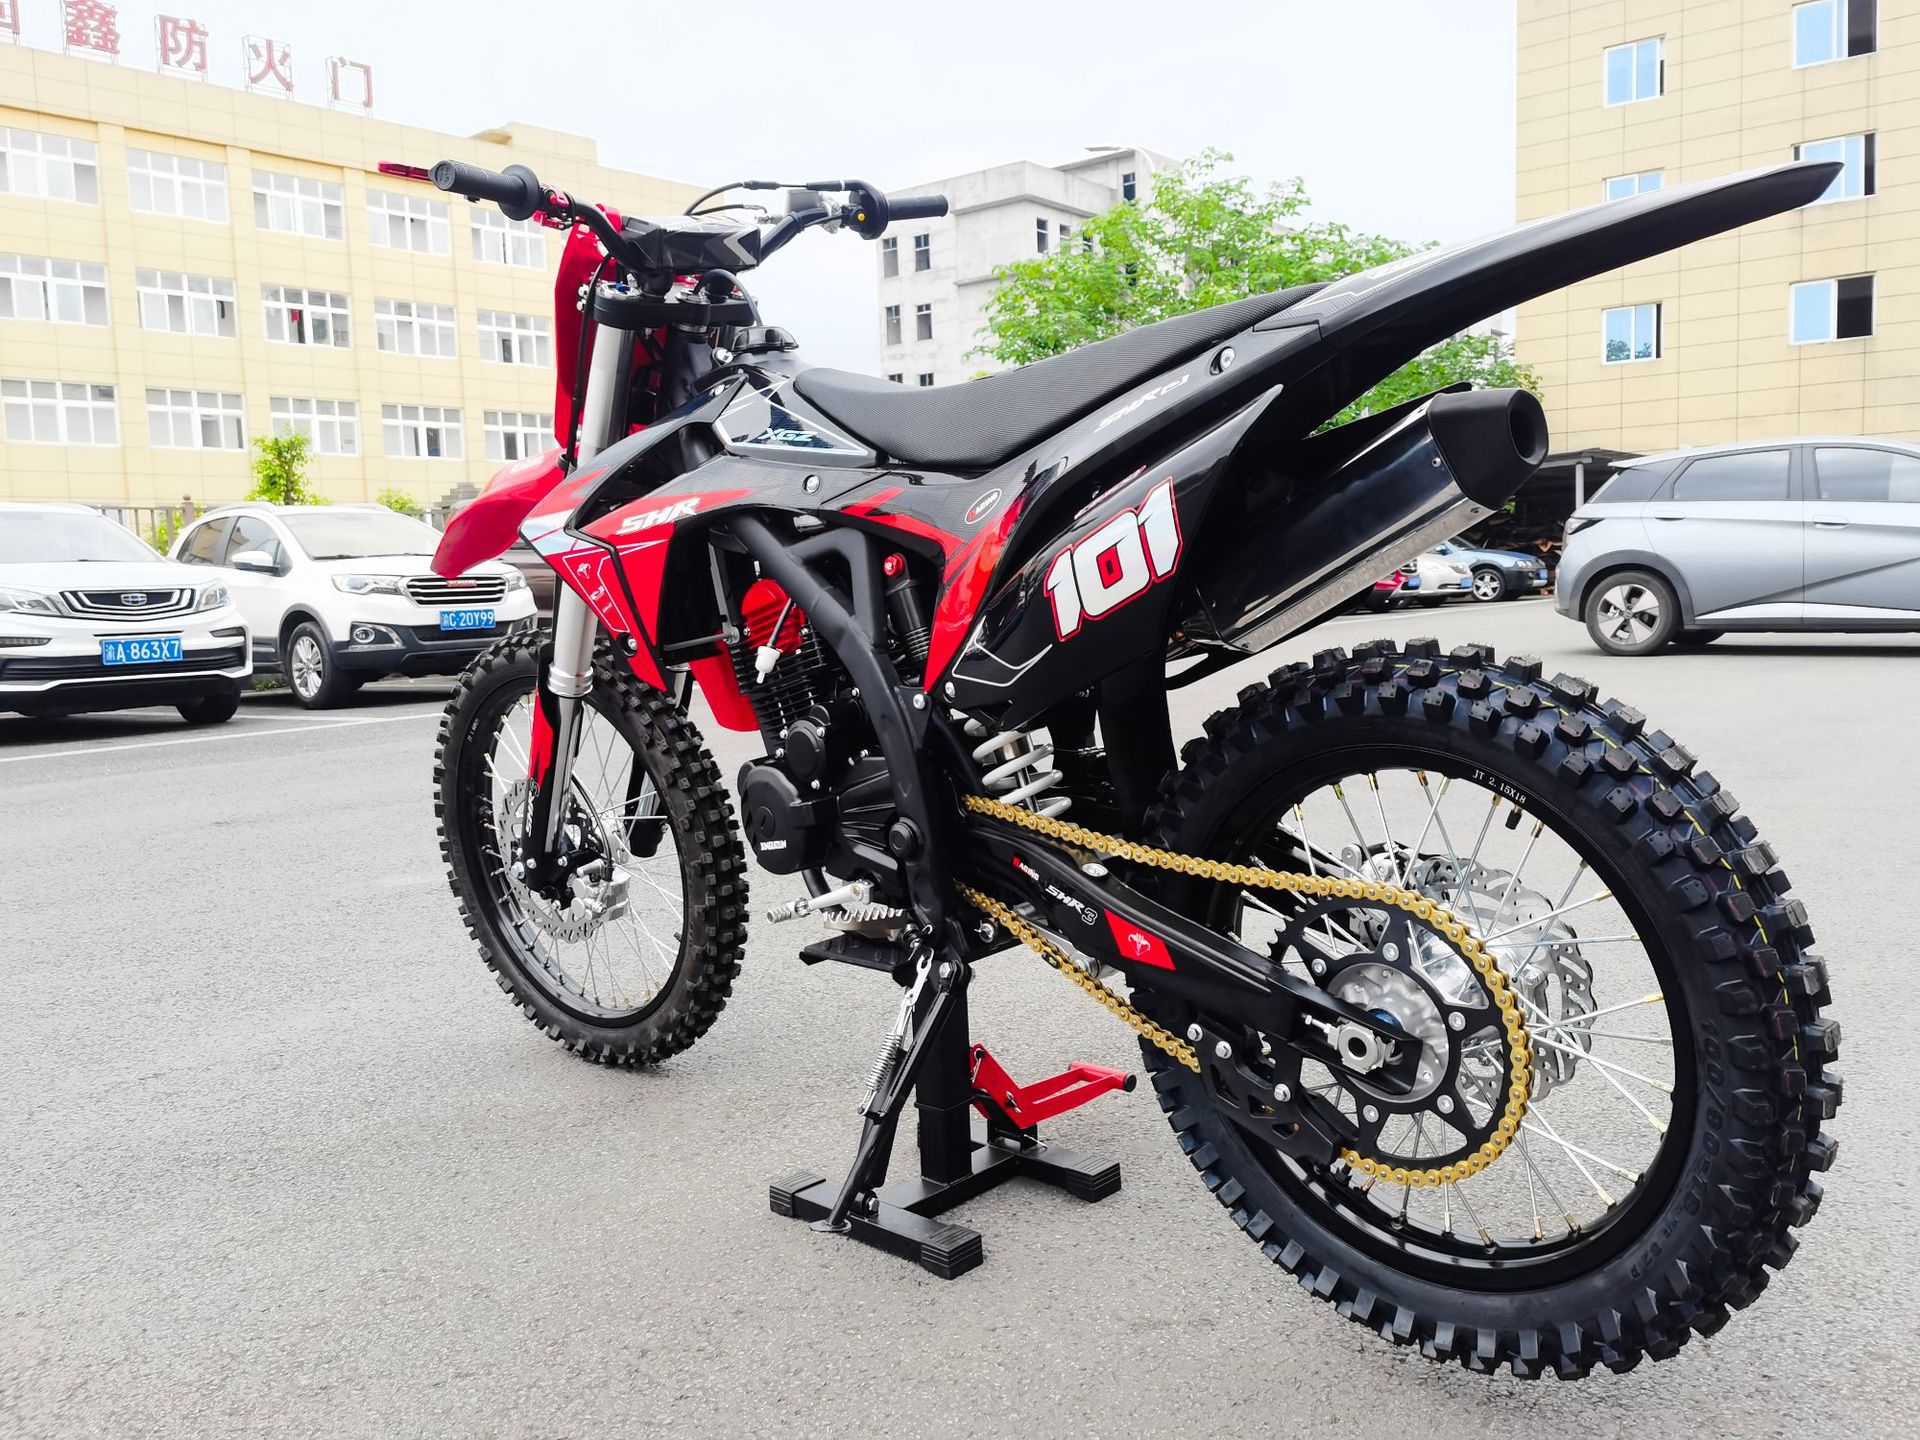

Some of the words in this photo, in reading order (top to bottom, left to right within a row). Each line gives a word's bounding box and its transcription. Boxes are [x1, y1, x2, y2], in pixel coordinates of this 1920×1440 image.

[616, 497, 702, 536] SHR
[1044, 476, 1183, 643] 101
[1472, 769, 1485, 780] JT
